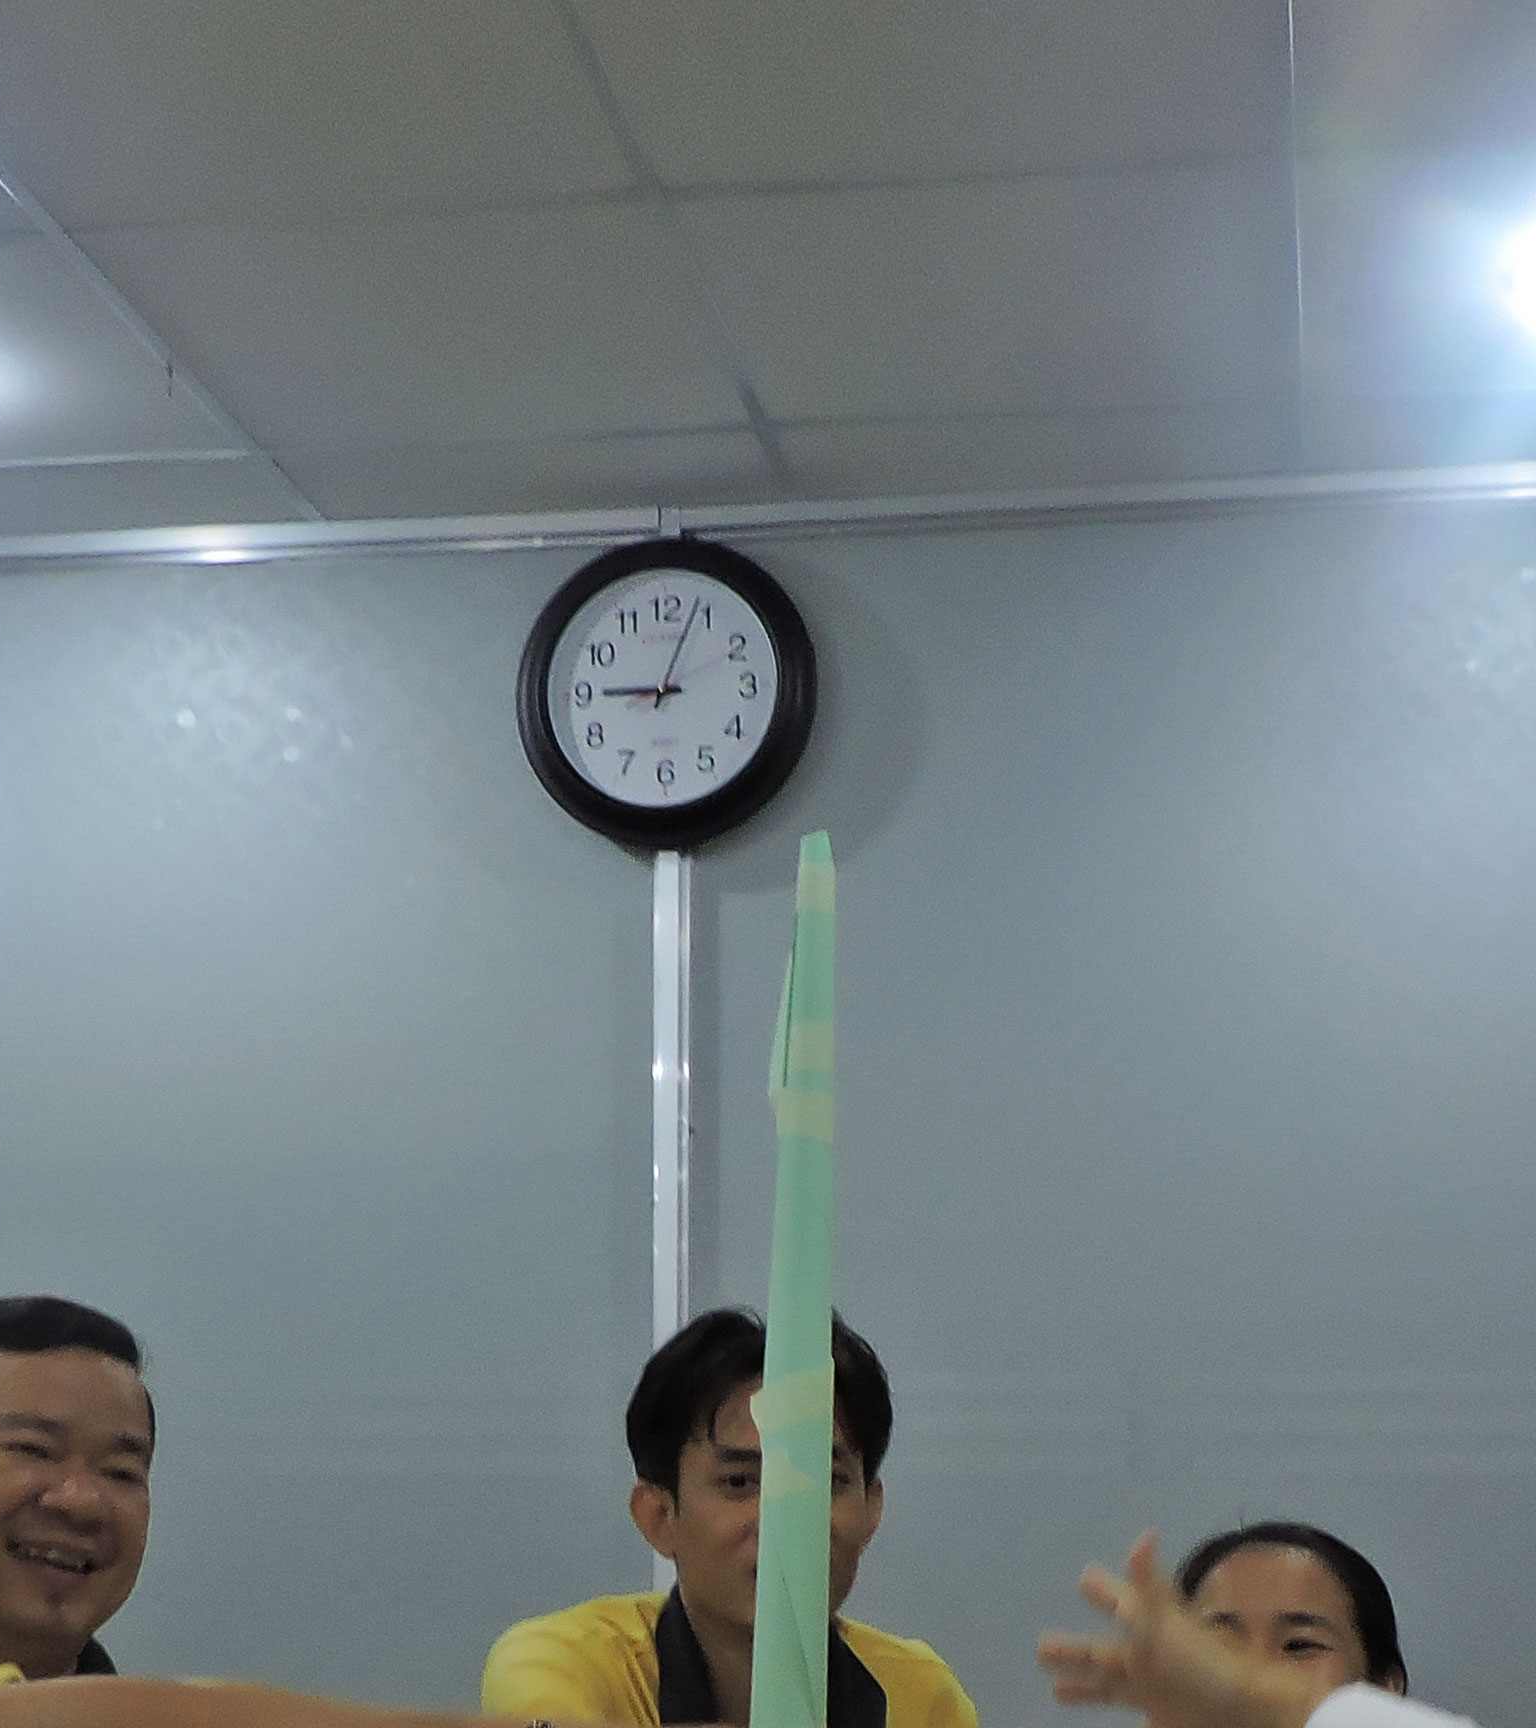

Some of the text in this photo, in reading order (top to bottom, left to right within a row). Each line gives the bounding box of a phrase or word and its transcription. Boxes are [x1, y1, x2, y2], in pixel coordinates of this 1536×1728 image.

[619, 609, 638, 634] 11
[652, 594, 682, 624] 12
[589, 640, 615, 667] 10
[728, 632, 747, 662] 2
[574, 681, 592, 708] 9
[738, 671, 758, 699] 3
[586, 721, 604, 748] 8
[724, 714, 742, 741] 4
[617, 749, 635, 776] 7
[656, 759, 675, 786] 6
[696, 745, 715, 773] 5
